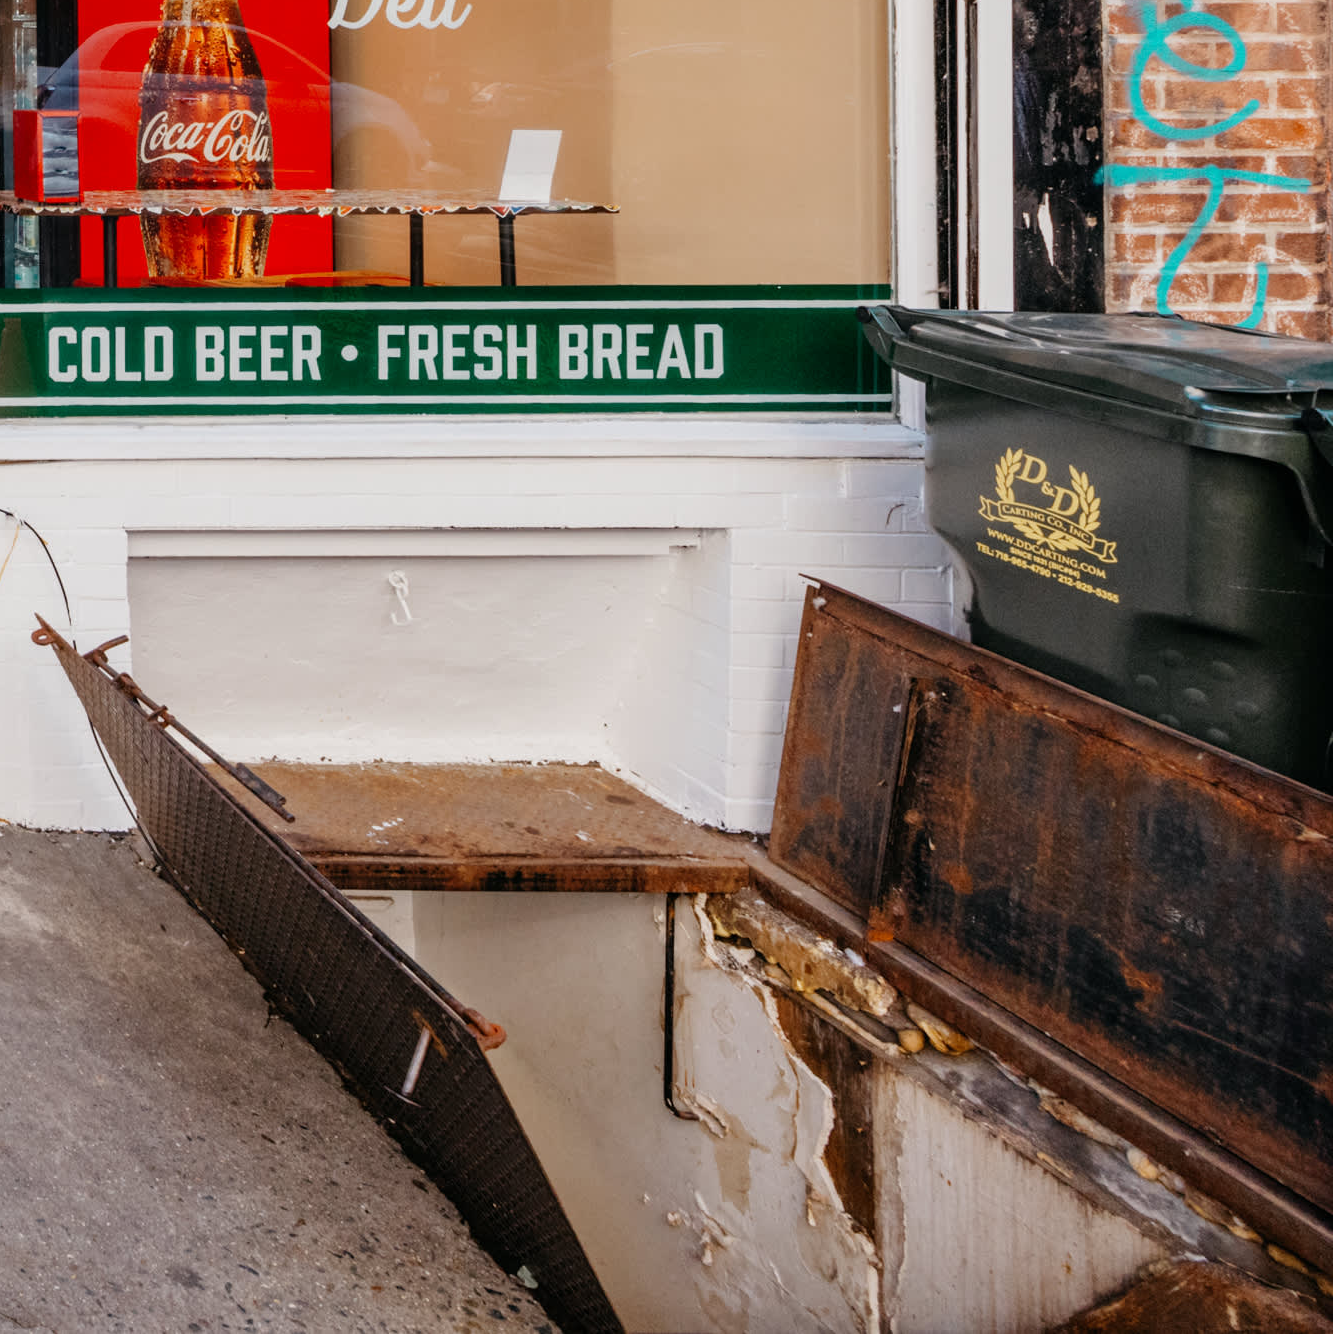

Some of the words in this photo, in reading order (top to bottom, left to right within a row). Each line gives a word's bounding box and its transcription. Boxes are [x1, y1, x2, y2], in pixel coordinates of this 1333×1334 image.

[140, 109, 271, 163] Coca-Cola
[48, 326, 174, 382] COLD
[196, 325, 322, 381] BEER
[378, 324, 537, 380] FRESH
[559, 324, 724, 379] BREAD
[976, 541, 994, 557] TEL:
[1002, 504, 1045, 523] CARTING
[1069, 526, 1091, 544] INC.
[986, 527, 1107, 579] WWW.DDCARTING.COM
